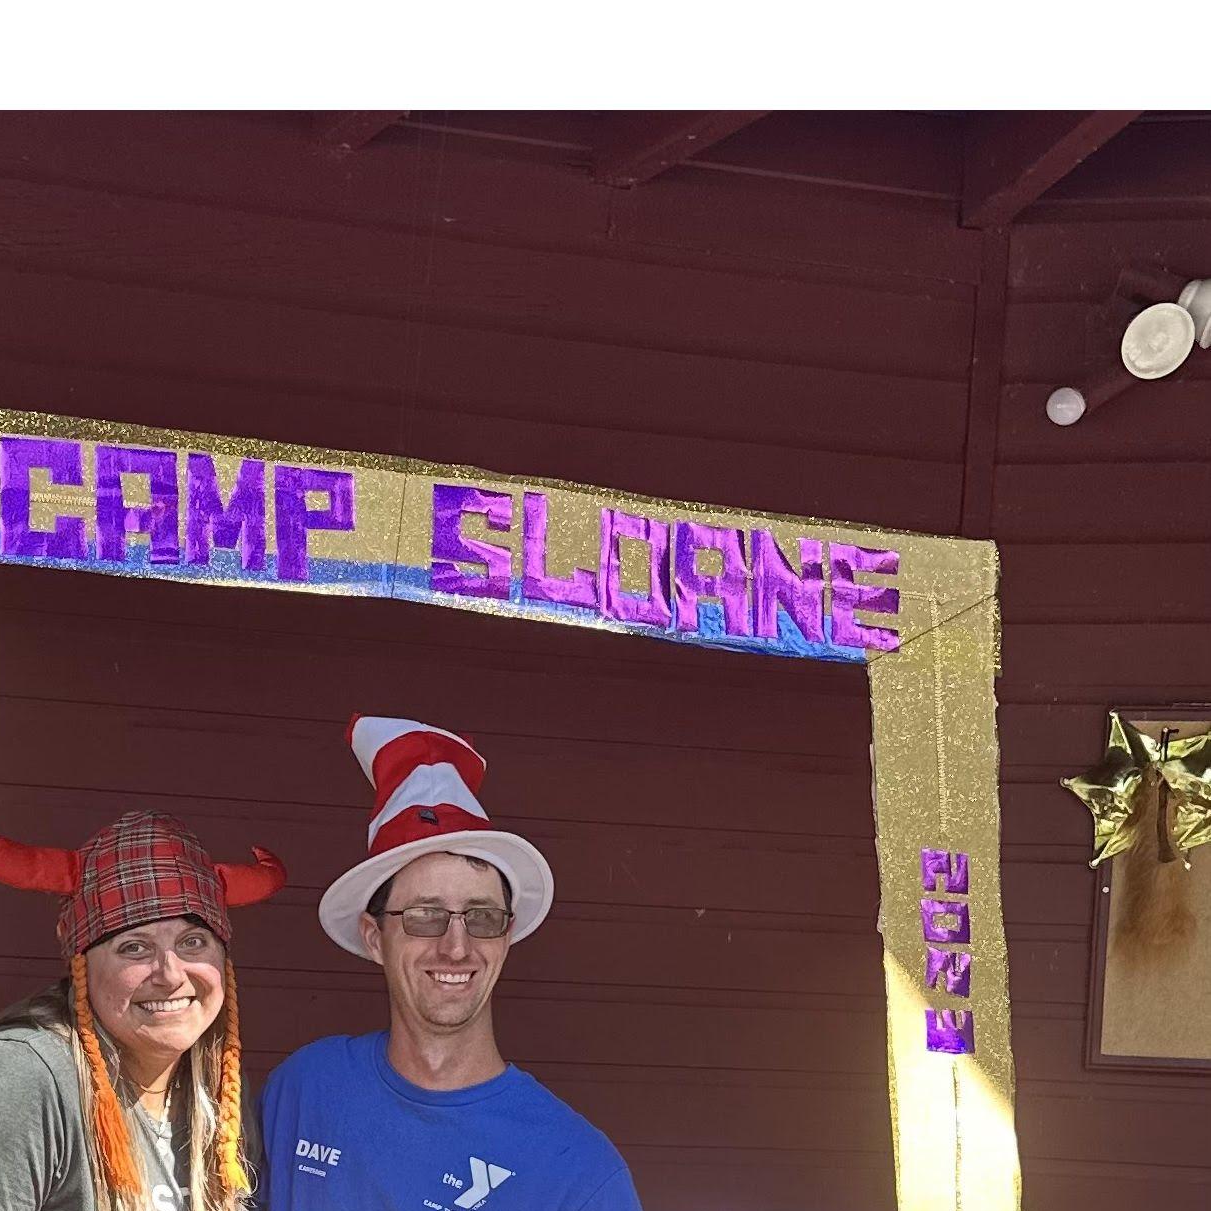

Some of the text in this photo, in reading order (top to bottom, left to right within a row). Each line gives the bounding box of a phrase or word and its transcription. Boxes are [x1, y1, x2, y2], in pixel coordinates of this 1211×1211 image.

[0, 436, 901, 654] CAMP SLOANE
[920, 848, 976, 1055] 2023
[295, 1139, 341, 1167] DAVE
[442, 1172, 464, 1189] the
[422, 1199, 443, 1211] CAMP
